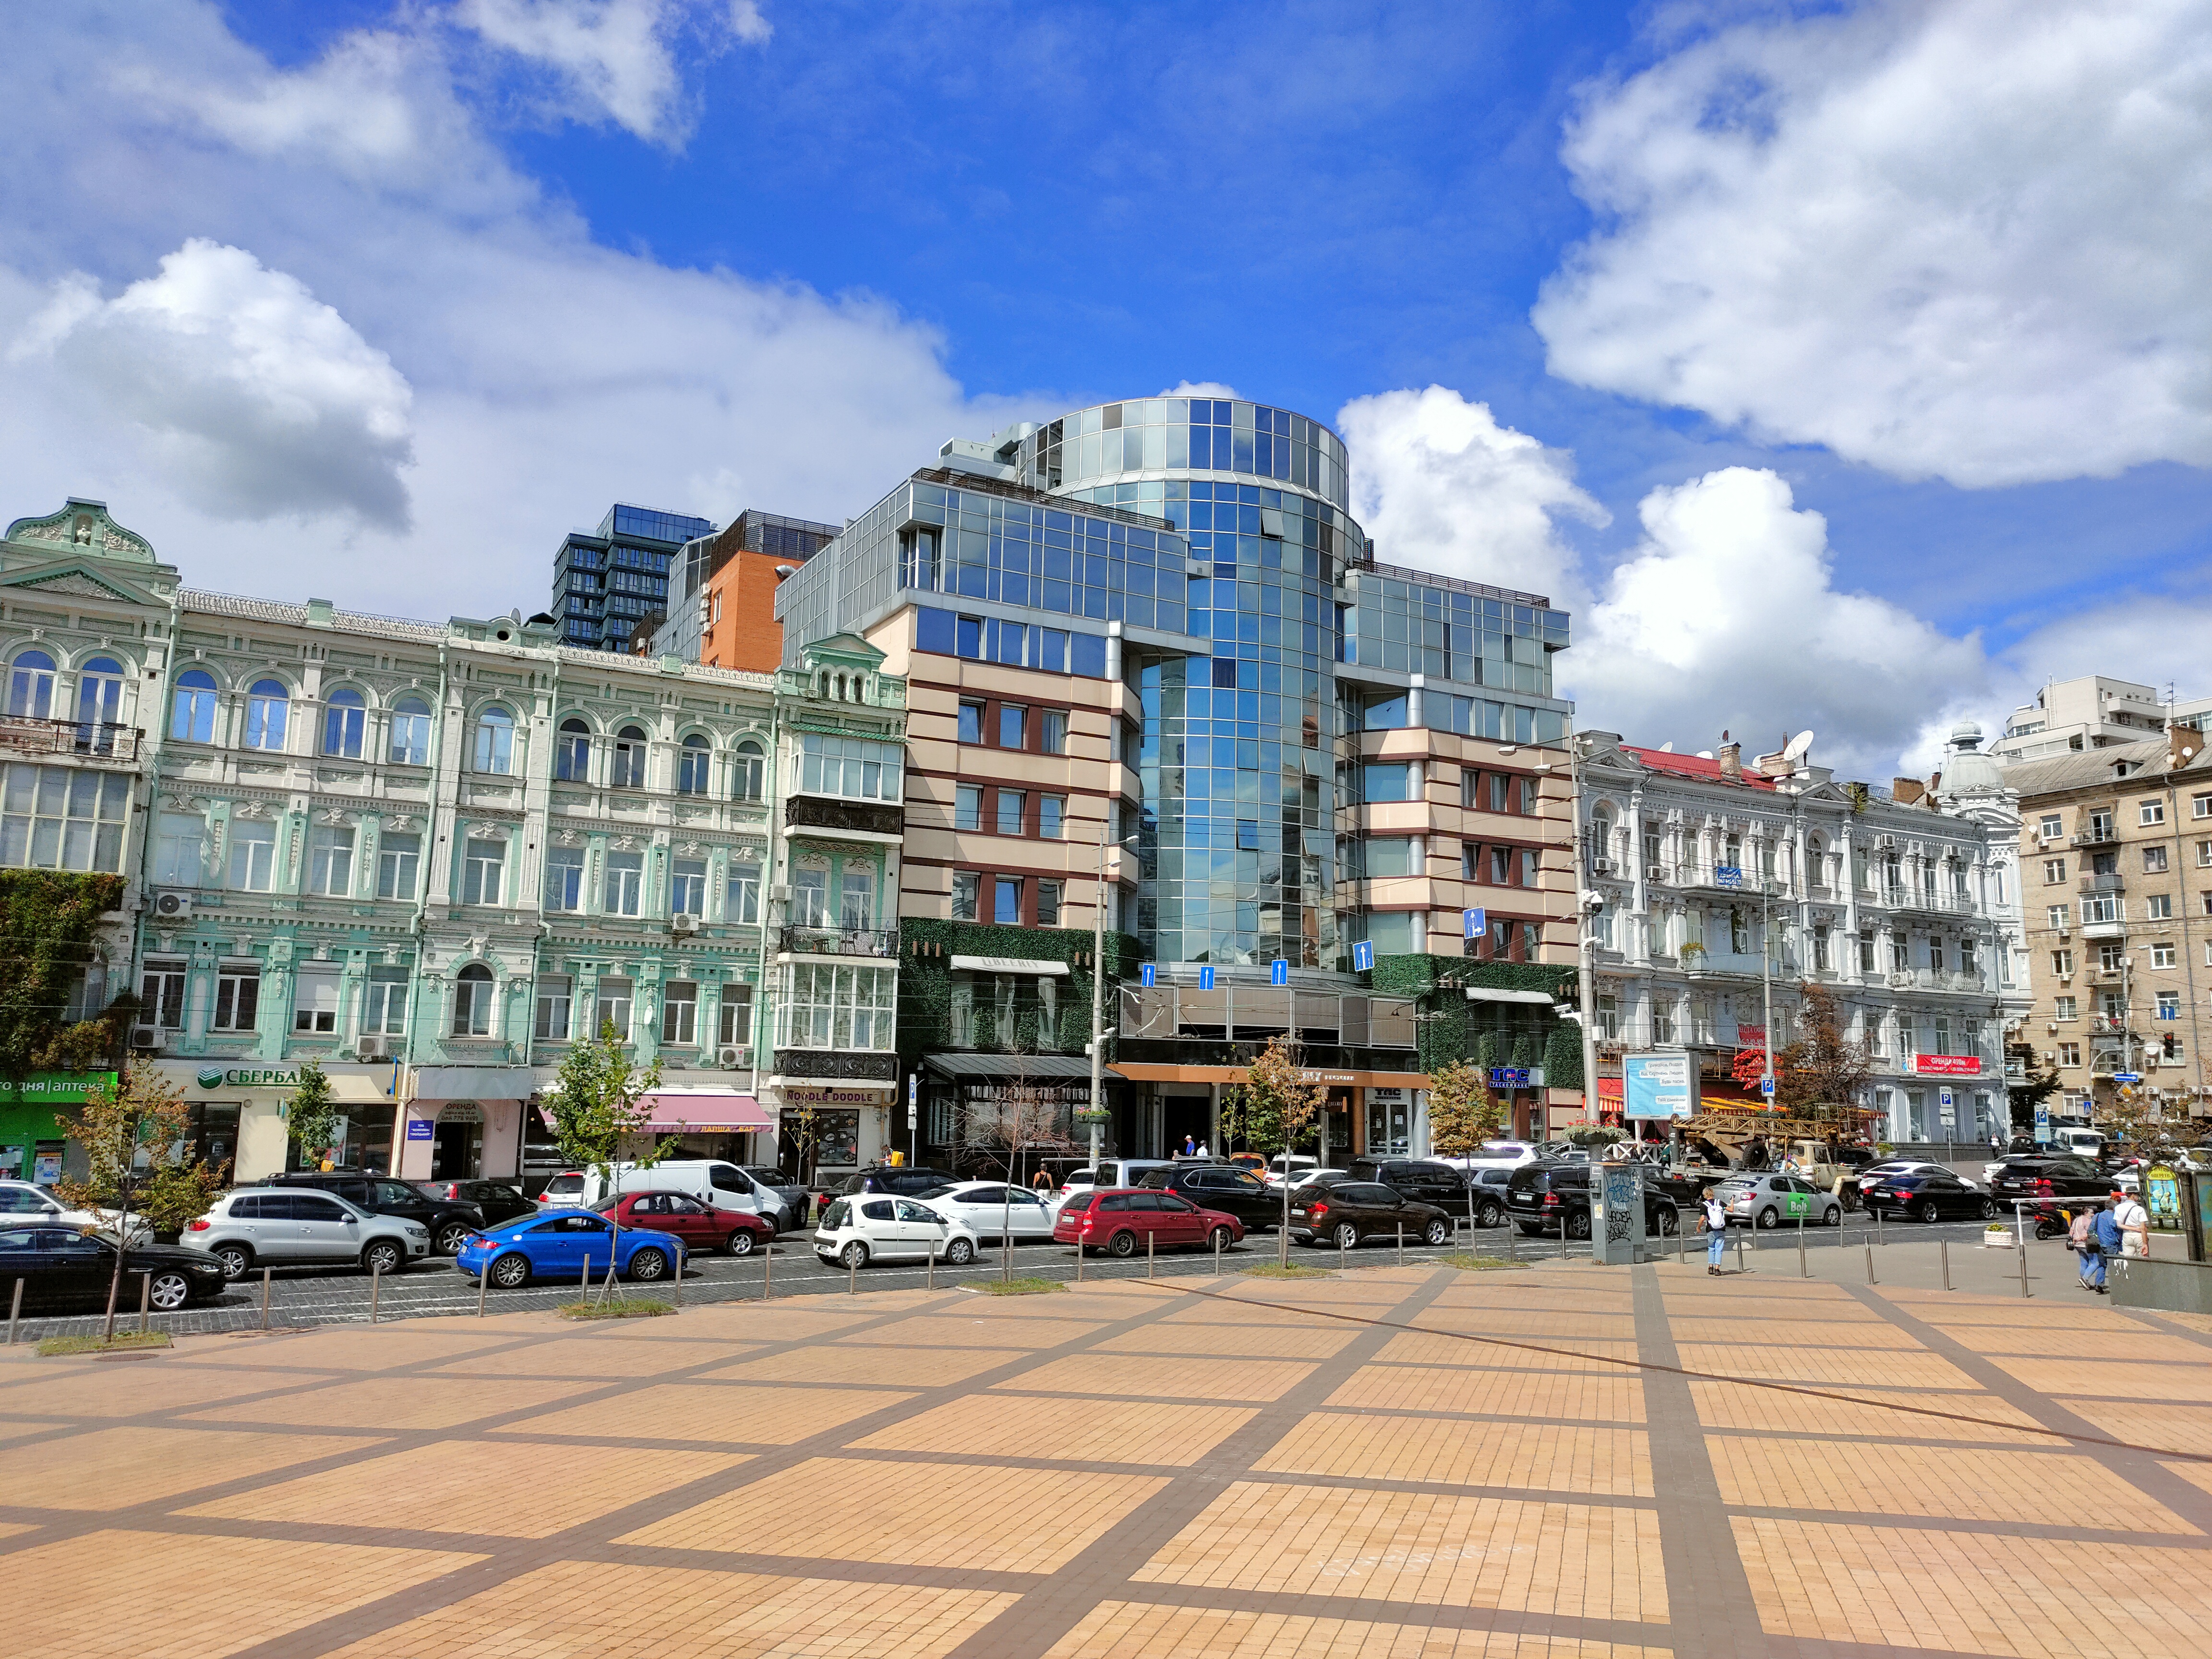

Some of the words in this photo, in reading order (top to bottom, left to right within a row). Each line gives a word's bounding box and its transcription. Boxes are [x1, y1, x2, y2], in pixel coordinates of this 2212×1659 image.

[1931, 1058, 1952, 1066] ОРЕНДА
[226, 1069, 303, 1083] СБЕРБА
[1765, 1081, 1772, 1091] P
[787, 1092, 828, 1101] NOODLE
[833, 1093, 873, 1101] DOODLE
[1943, 1094, 1949, 1104] P
[2038, 1112, 2045, 1122] P
[1791, 1201, 1807, 1213] Bolt
